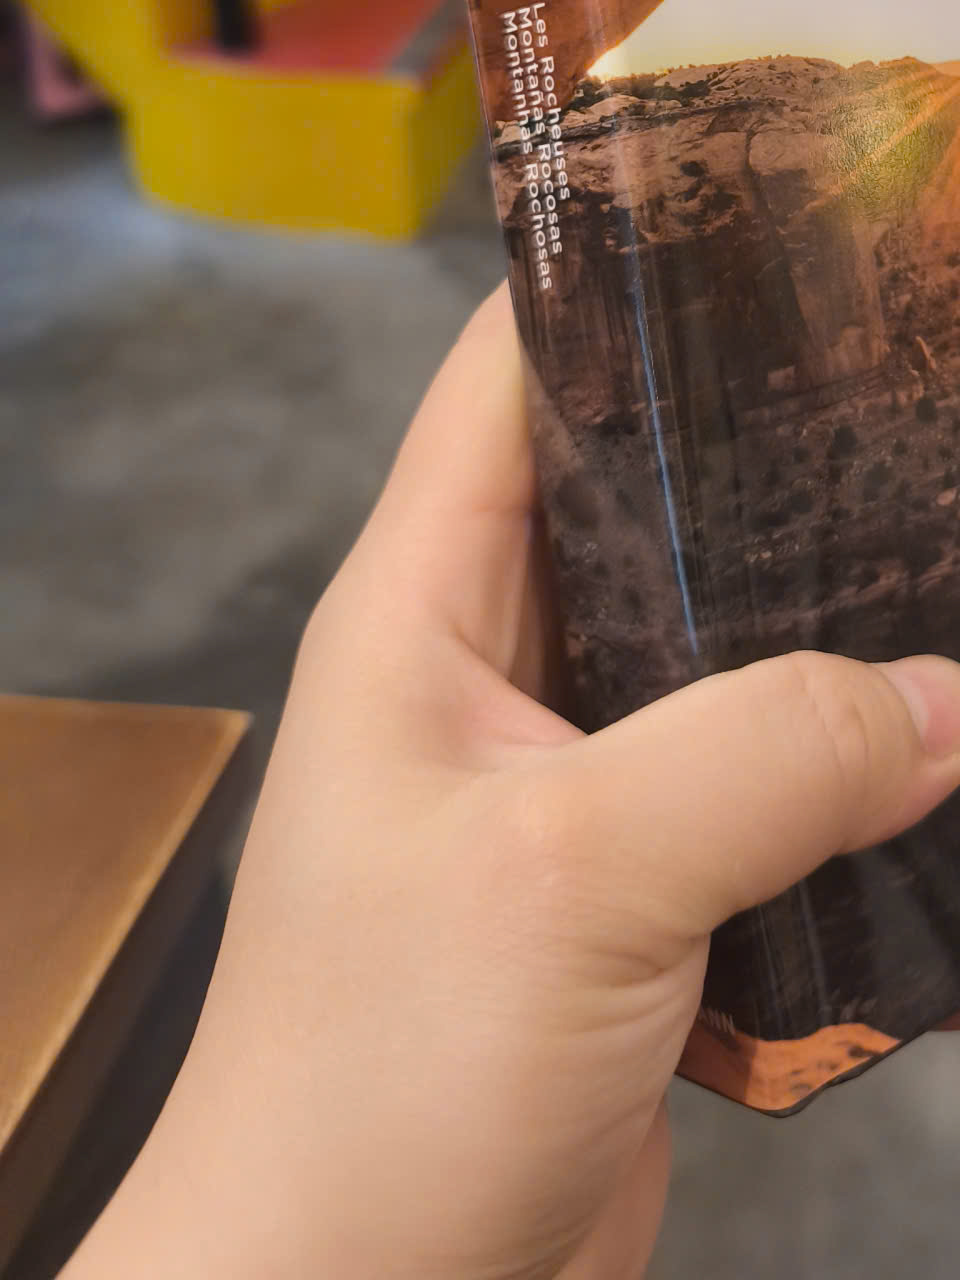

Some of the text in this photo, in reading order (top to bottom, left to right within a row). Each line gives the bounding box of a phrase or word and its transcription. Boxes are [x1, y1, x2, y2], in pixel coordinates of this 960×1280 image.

[503, 10, 552, 289] Montanhas Rochosas
[517, 6, 563, 254] Montañas Rocosas
[532, 2, 570, 200] Les Rocheuses
